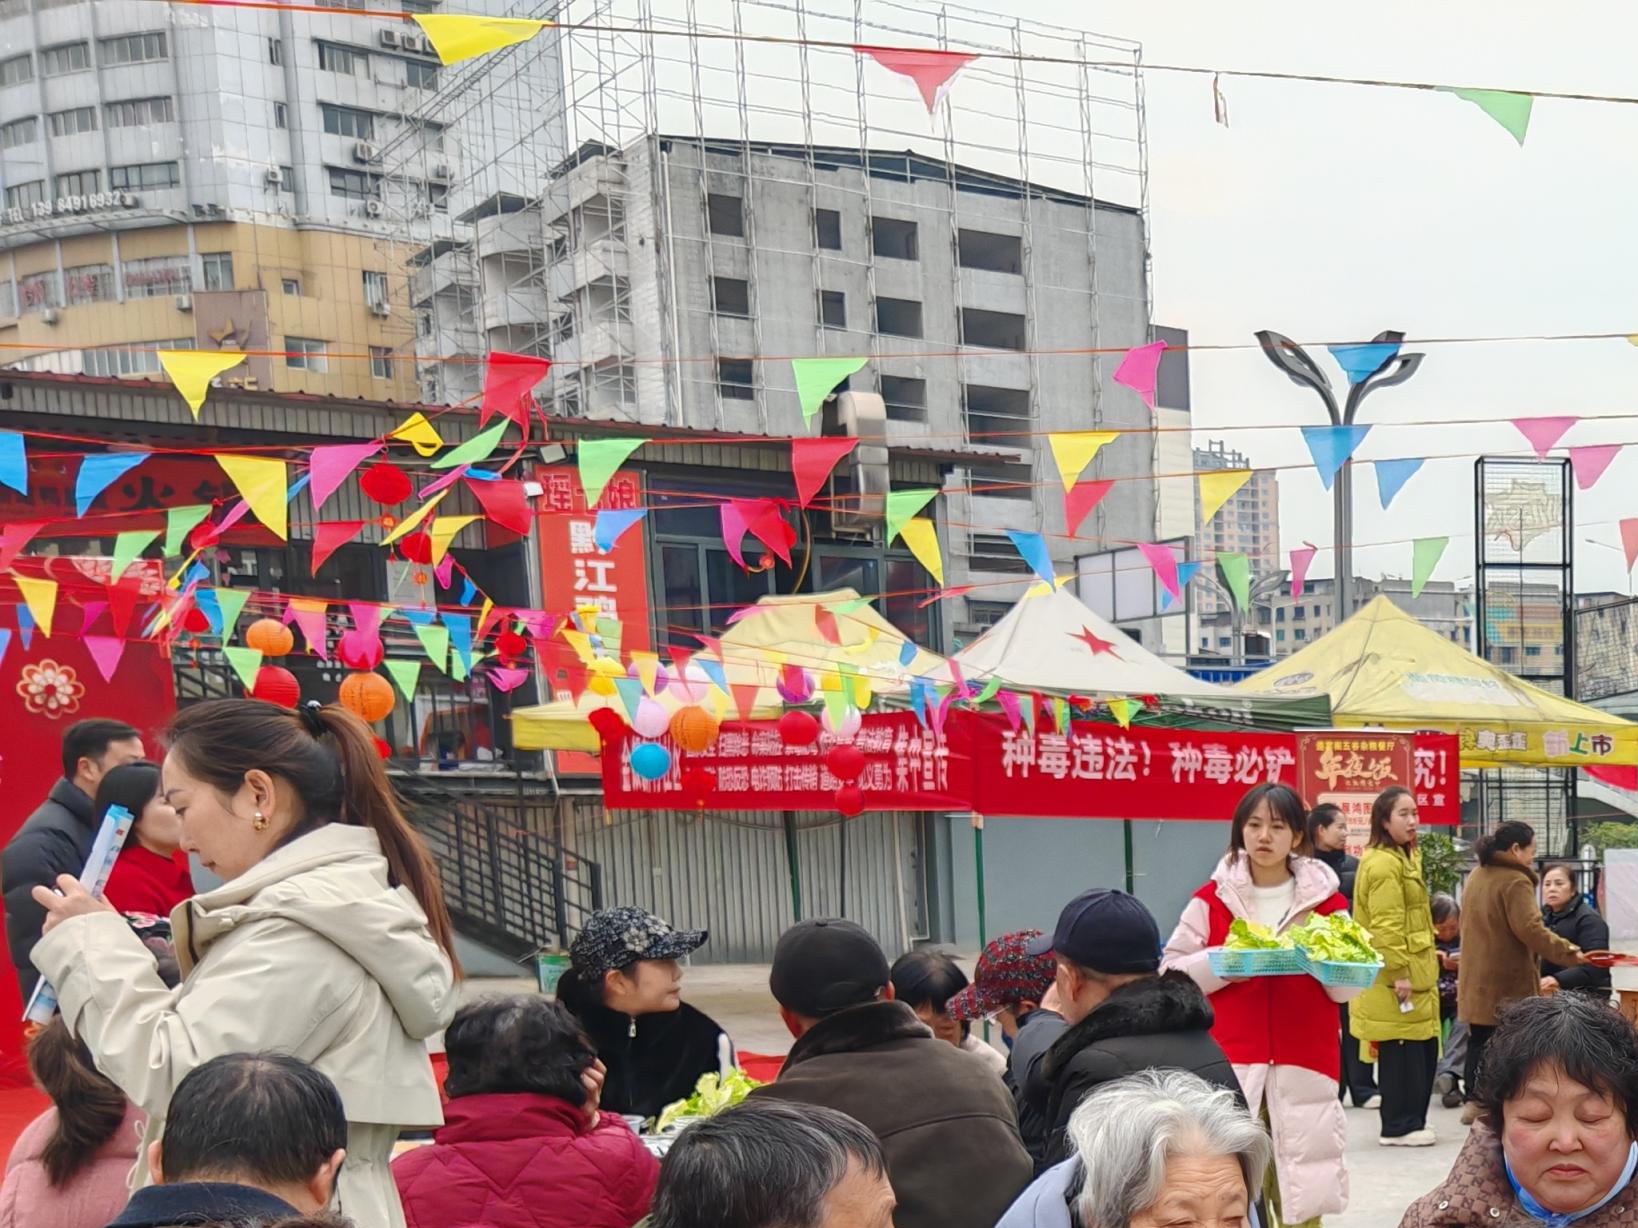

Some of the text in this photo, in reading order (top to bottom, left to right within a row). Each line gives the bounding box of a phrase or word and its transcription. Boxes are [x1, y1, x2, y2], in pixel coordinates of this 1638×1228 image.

[31, 200, 52, 217] 139
[541, 473, 636, 512] 瑶娘
[1001, 729, 1152, 782] 种毒违法！
[1170, 739, 1296, 786] 种毒必铲
[1314, 750, 1399, 791] 年夜饭
